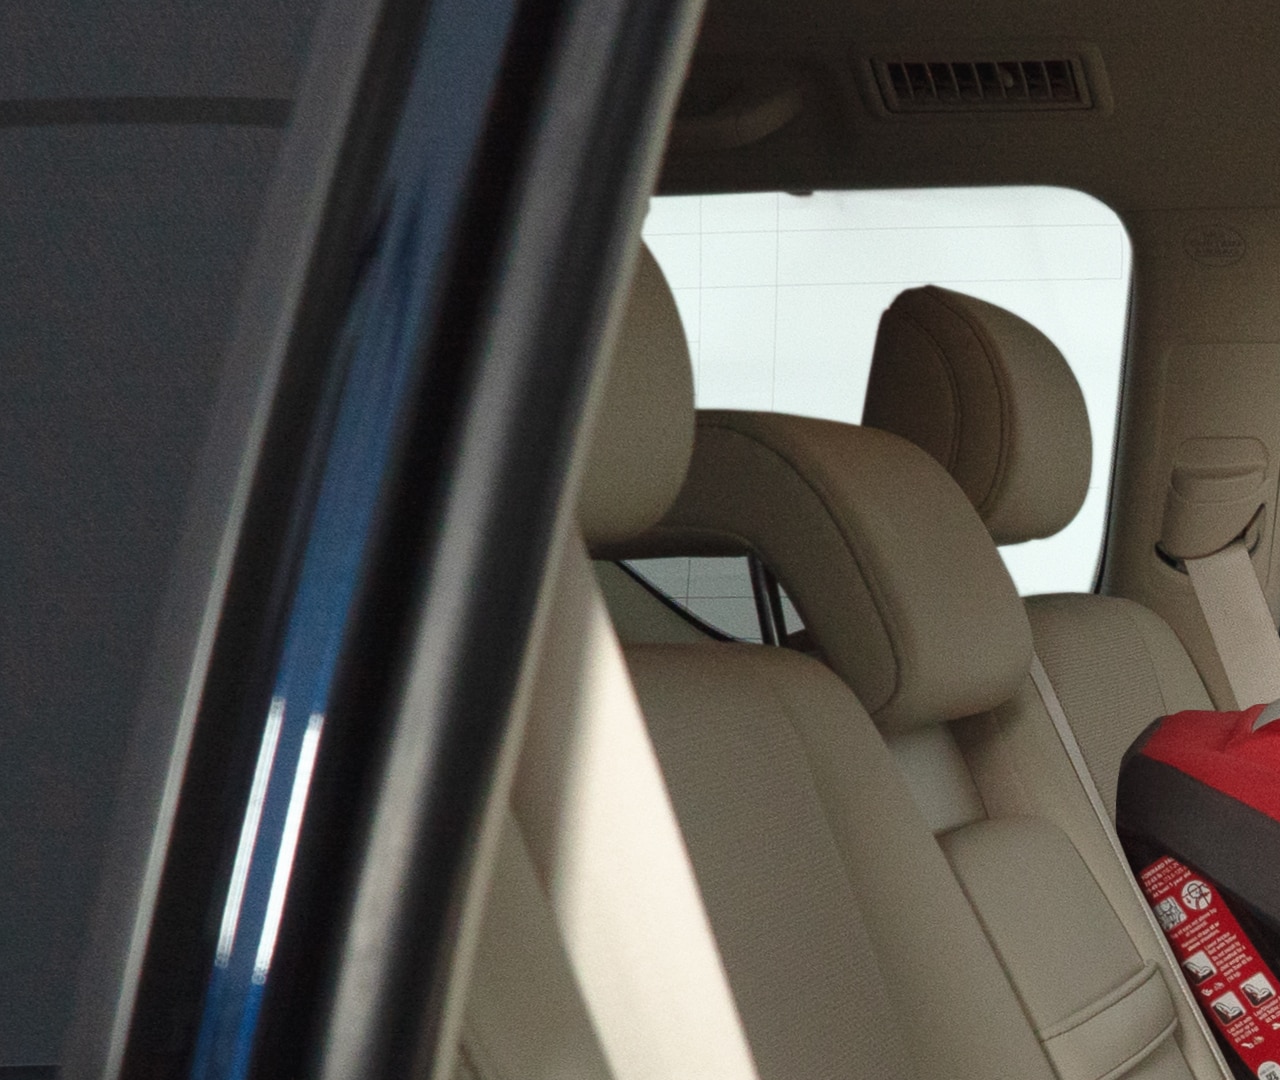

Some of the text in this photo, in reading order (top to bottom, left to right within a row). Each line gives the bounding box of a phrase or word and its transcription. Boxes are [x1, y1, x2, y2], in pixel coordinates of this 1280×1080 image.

[1158, 884, 1170, 895] least
[1172, 875, 1184, 886] year
[1182, 870, 1192, 878] old
